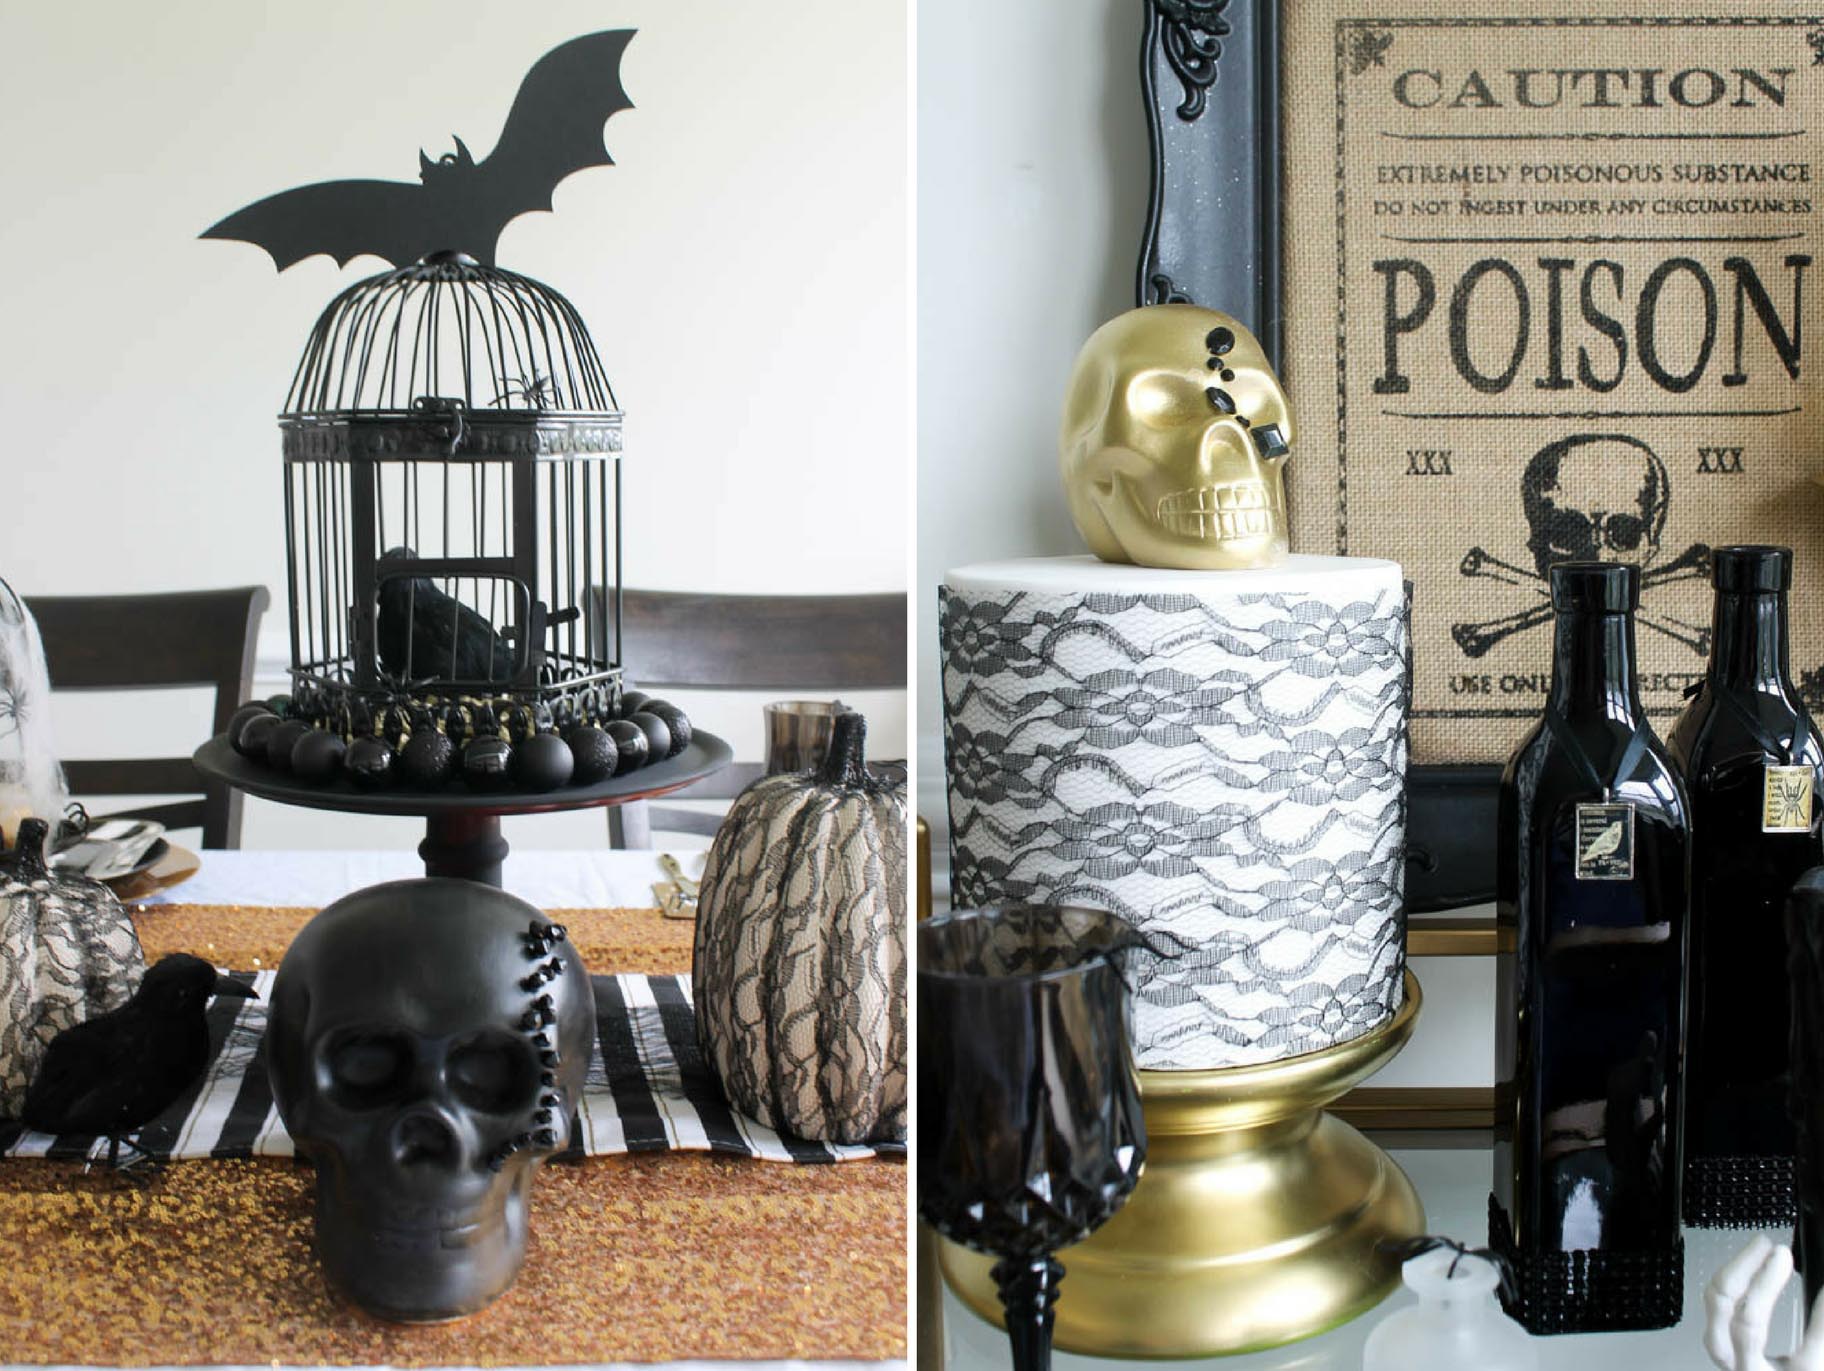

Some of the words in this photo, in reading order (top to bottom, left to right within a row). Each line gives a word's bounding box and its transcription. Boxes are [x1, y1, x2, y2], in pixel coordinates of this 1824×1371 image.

[1393, 67, 1795, 109] CAUTION
[1376, 164, 1509, 185] EXTREMELY
[1520, 164, 1663, 184] POISONOUS
[1672, 163, 1810, 183] SUBSTANCE
[1374, 200, 1404, 216] DO
[1411, 200, 1450, 217] NOT
[1459, 199, 1526, 217] INGEST
[1534, 200, 1601, 216] UNDER
[1607, 199, 1647, 216] ANY
[1652, 199, 1812, 215] CIRCUMSTANCES
[1373, 254, 1812, 394] POISON
[1405, 449, 1453, 476] XXX
[1697, 446, 1745, 474] XXX
[1500, 673, 1552, 694] ONL
